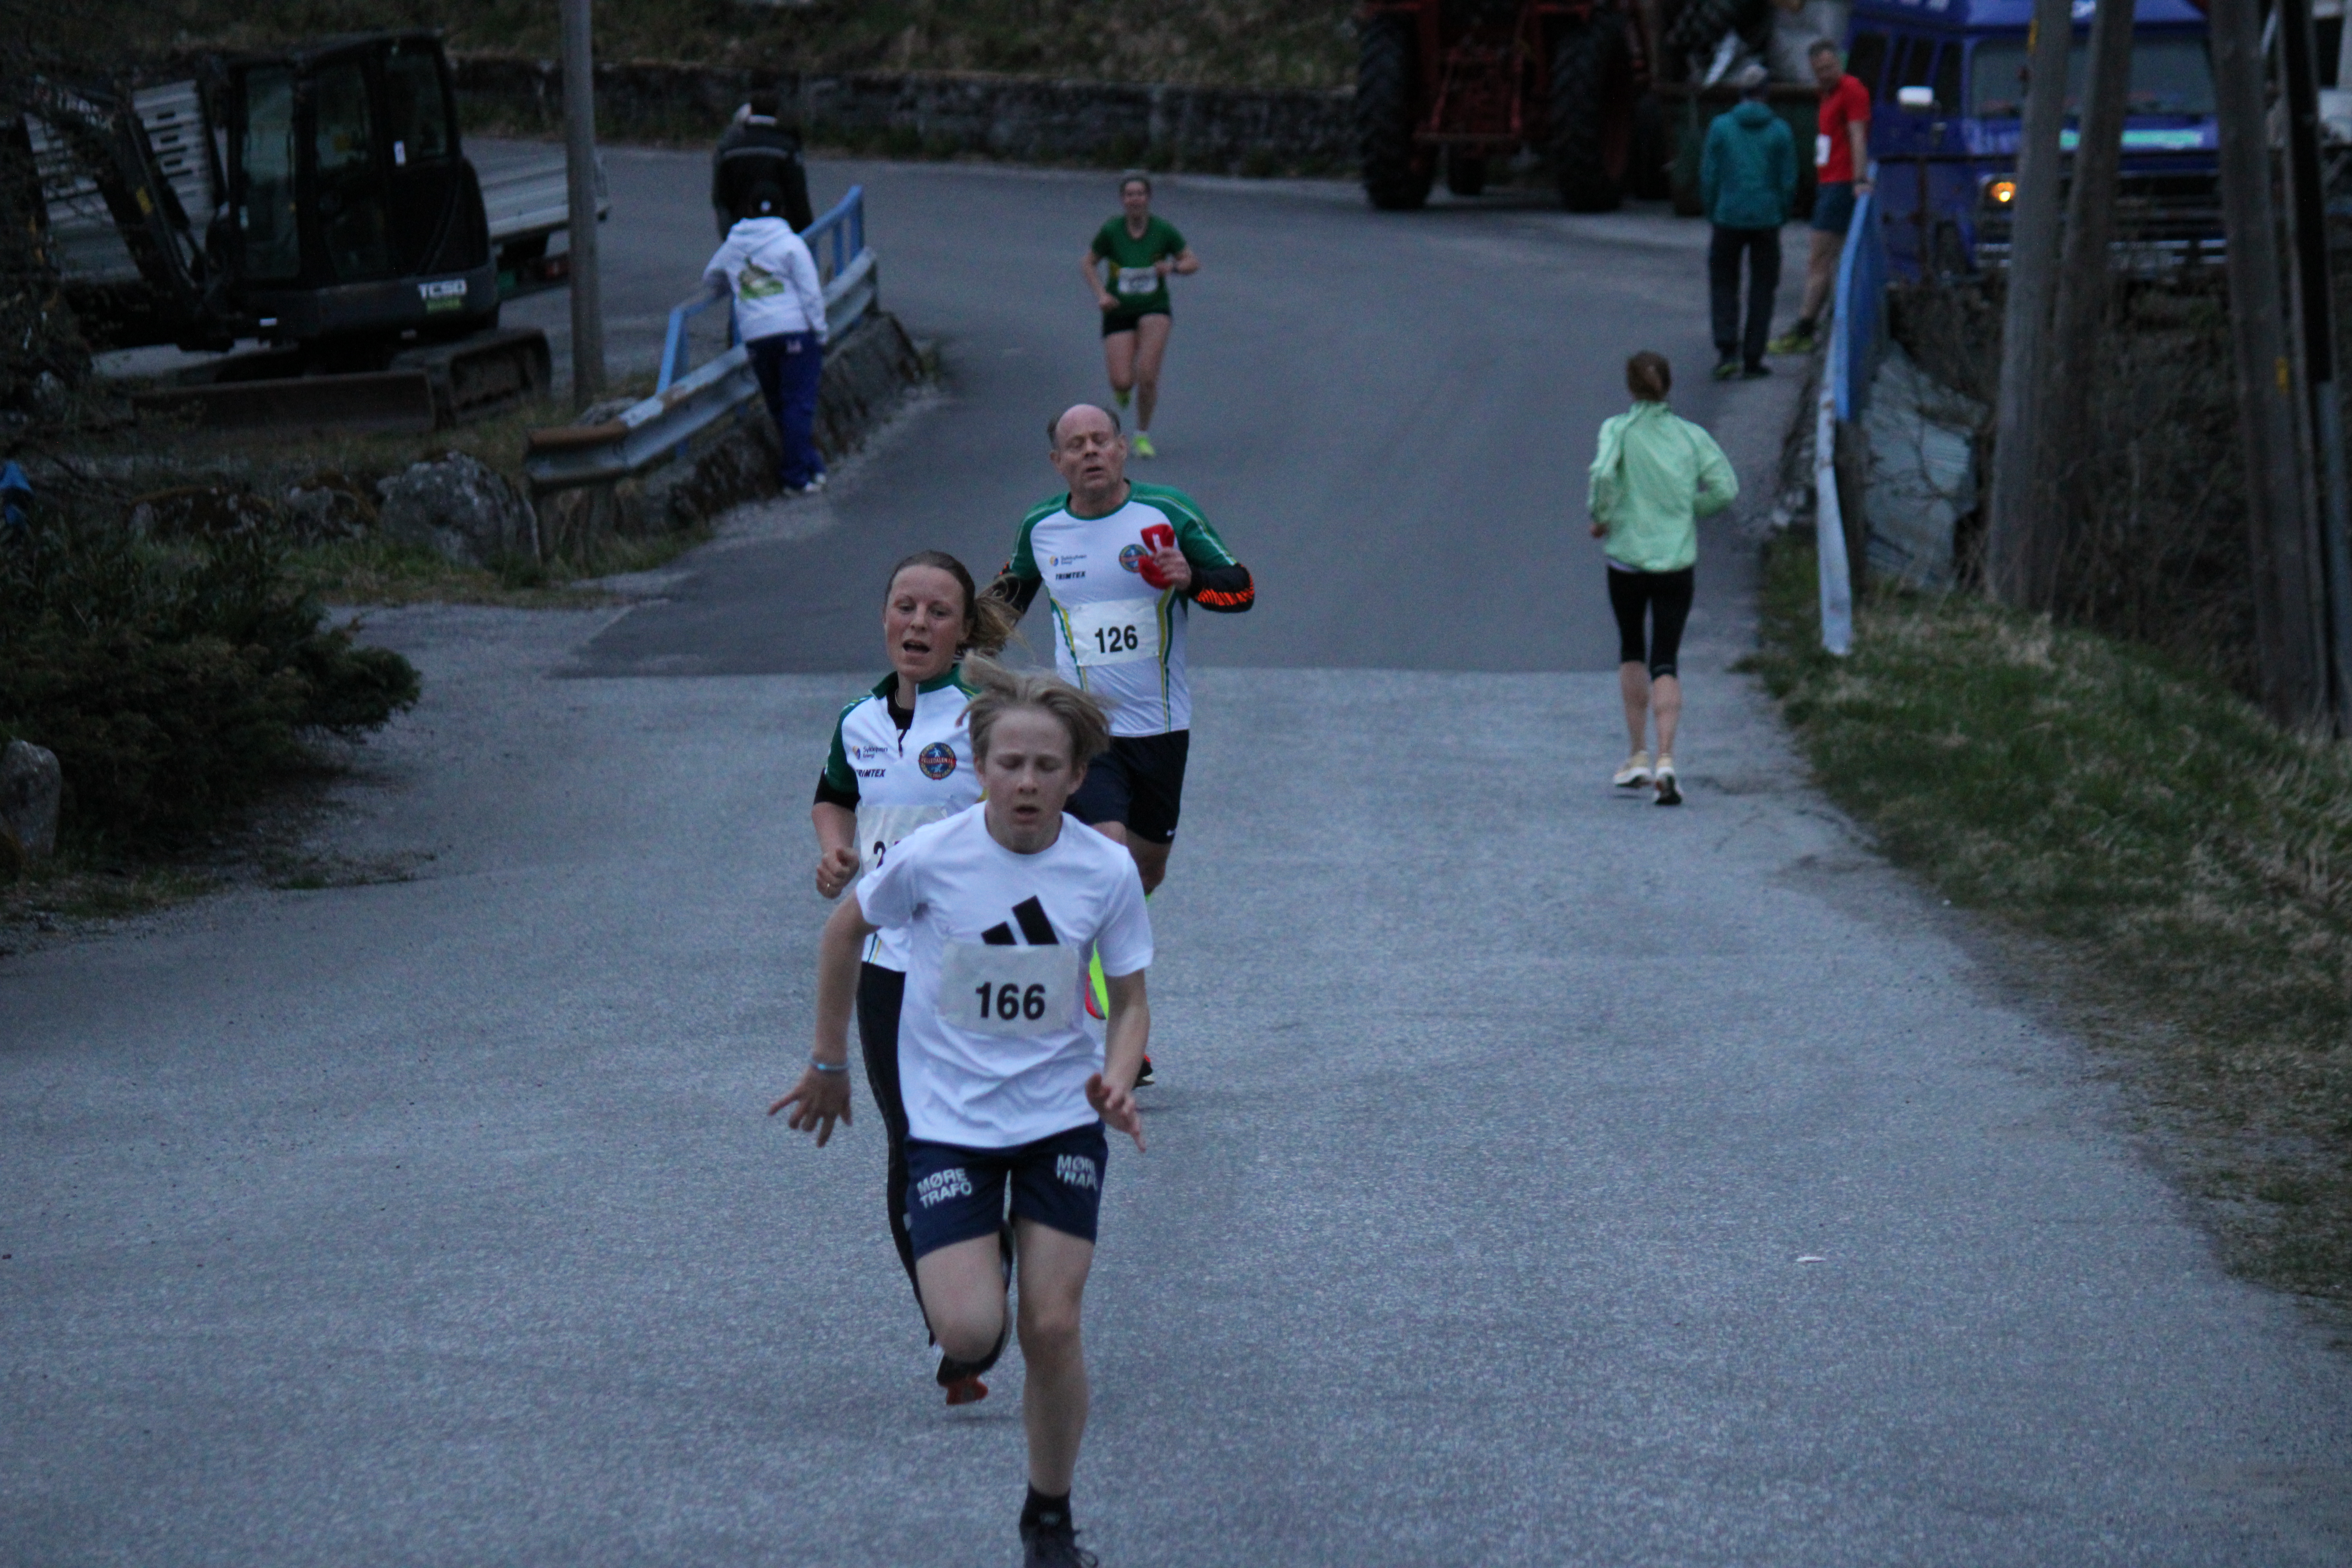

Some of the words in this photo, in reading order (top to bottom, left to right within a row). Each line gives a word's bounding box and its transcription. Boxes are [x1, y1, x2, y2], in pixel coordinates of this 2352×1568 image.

[1095, 625, 1138, 653] 126
[976, 982, 1045, 1020] 166
[917, 1168, 967, 1195] MØRE
[919, 1181, 972, 1208] TRAFO
